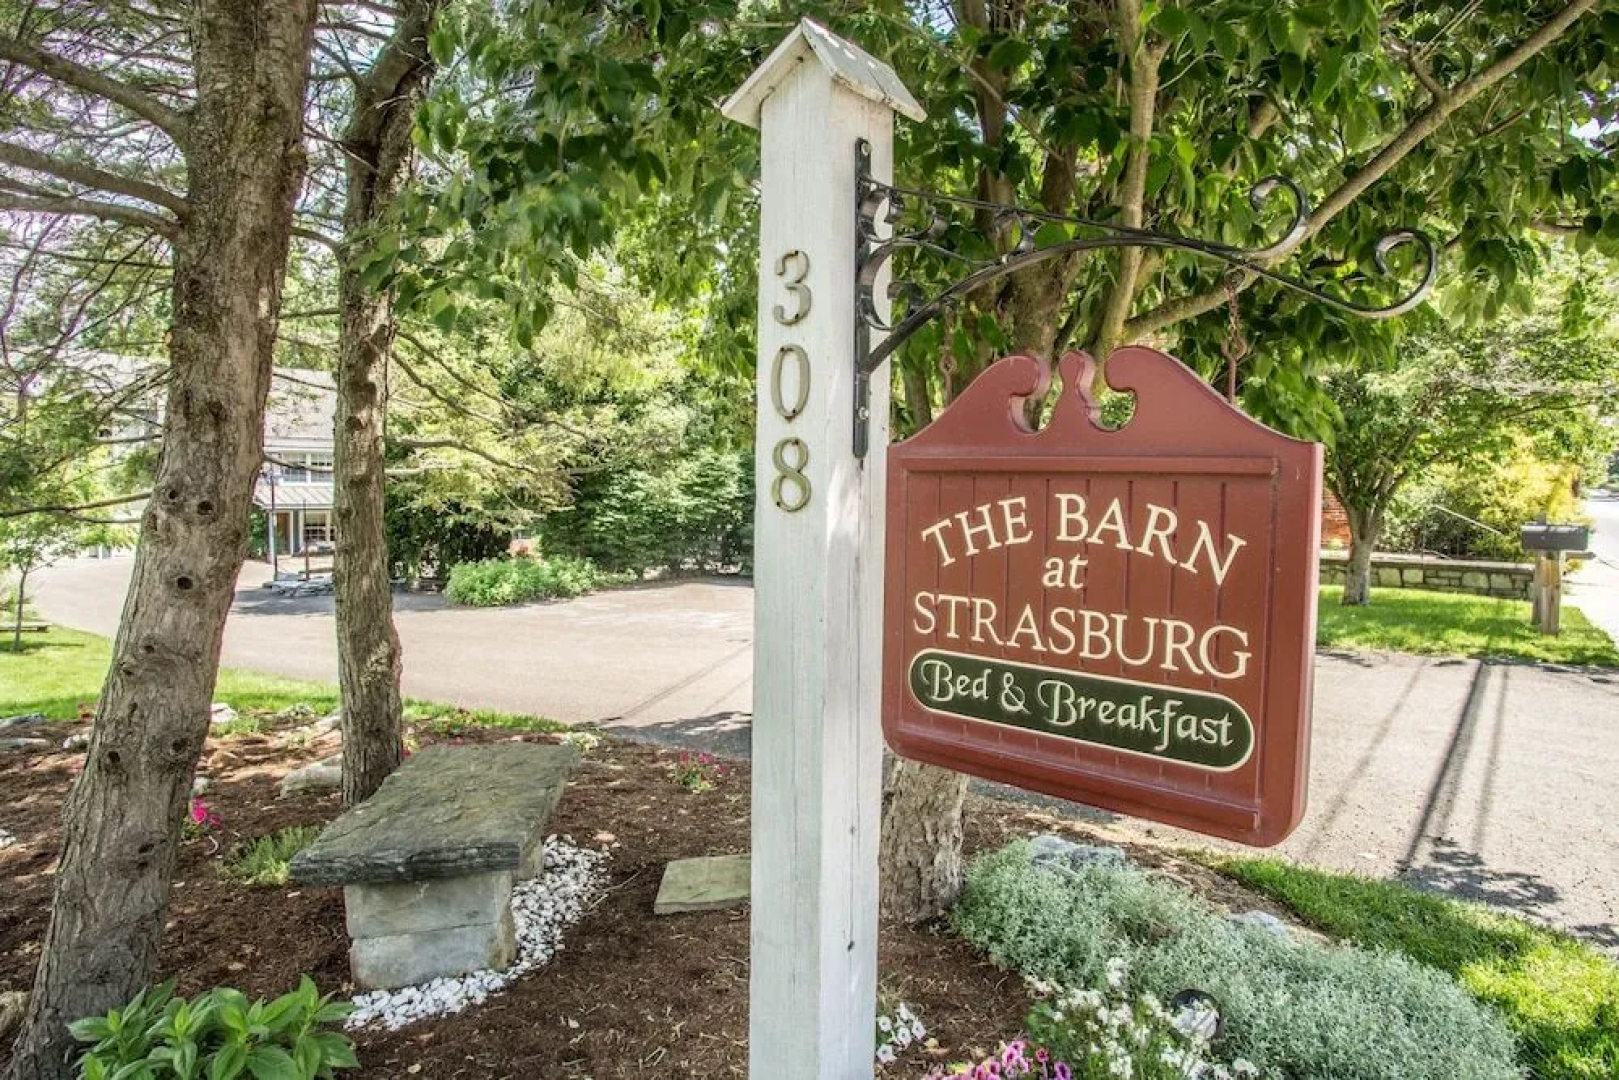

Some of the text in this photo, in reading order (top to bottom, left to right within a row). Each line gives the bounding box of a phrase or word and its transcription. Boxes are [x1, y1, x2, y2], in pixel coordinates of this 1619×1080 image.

[771, 250, 812, 512] 308
[922, 493, 1247, 586] THE BARN
[1041, 555, 1089, 590] at
[913, 591, 1252, 680] STRASBURG
[920, 660, 1235, 752] Bed & Breakfast
